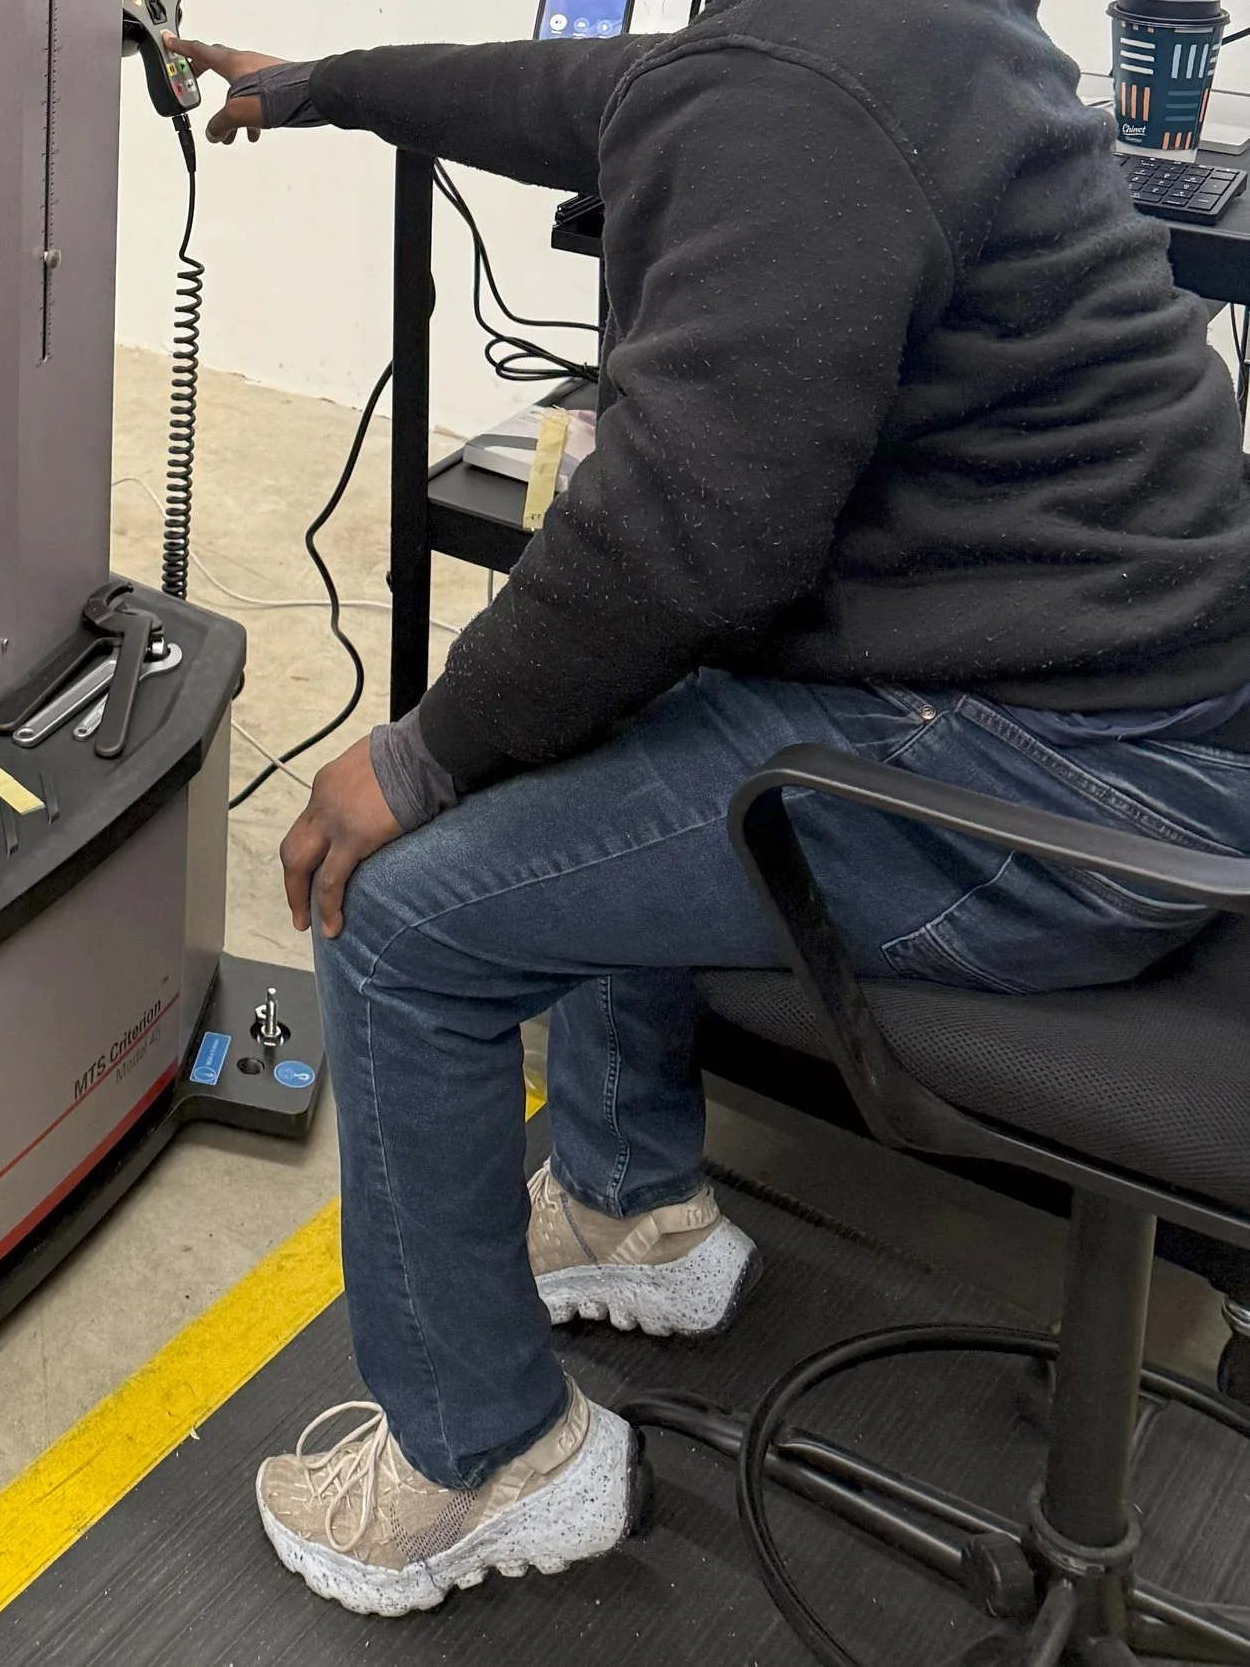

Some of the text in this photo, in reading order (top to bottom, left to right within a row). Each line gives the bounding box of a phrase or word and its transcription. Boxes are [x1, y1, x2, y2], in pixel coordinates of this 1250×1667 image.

[74, 1055, 105, 1099] MTS
[110, 1000, 161, 1063] Criterion
[116, 1037, 148, 1086] Model
